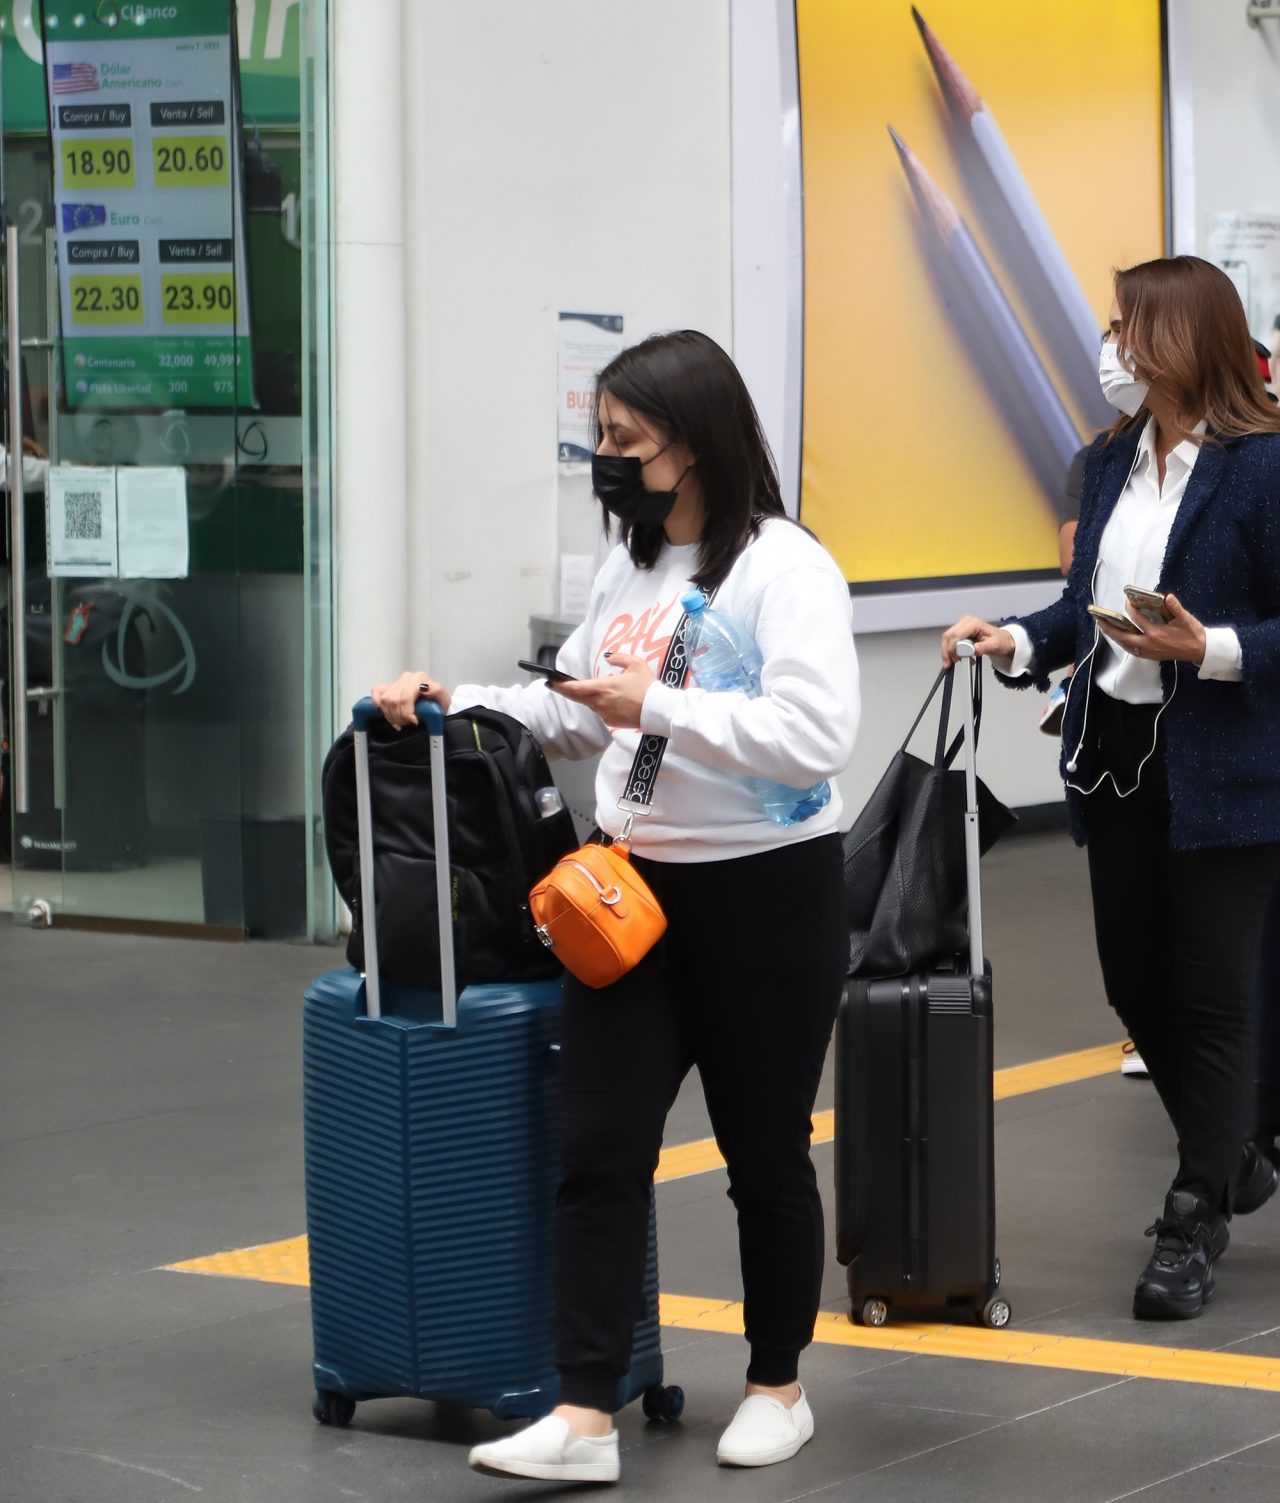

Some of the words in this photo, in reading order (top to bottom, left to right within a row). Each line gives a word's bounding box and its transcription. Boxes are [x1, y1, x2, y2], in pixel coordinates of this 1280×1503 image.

[101, 63, 131, 75] Dólar
[101, 78, 162, 90] Americano
[63, 112, 99, 124] Compra
[108, 111, 126, 122] Buy
[160, 108, 187, 120] Venta
[197, 107, 213, 118] Sell
[67, 150, 131, 176] 18.90
[157, 146, 224, 173] 20.60
[19, 199, 42, 245] 2
[110, 213, 140, 225] Euro
[71, 246, 108, 259] Compra
[117, 245, 134, 259] Buy
[169, 245, 196, 256] Venta
[205, 244, 222, 255] Sell
[74, 286, 139, 311] 22.30
[165, 284, 232, 310] 23.90
[158, 354, 194, 369] 32,000
[168, 381, 188, 393] 300
[213, 381, 233, 393] 975
